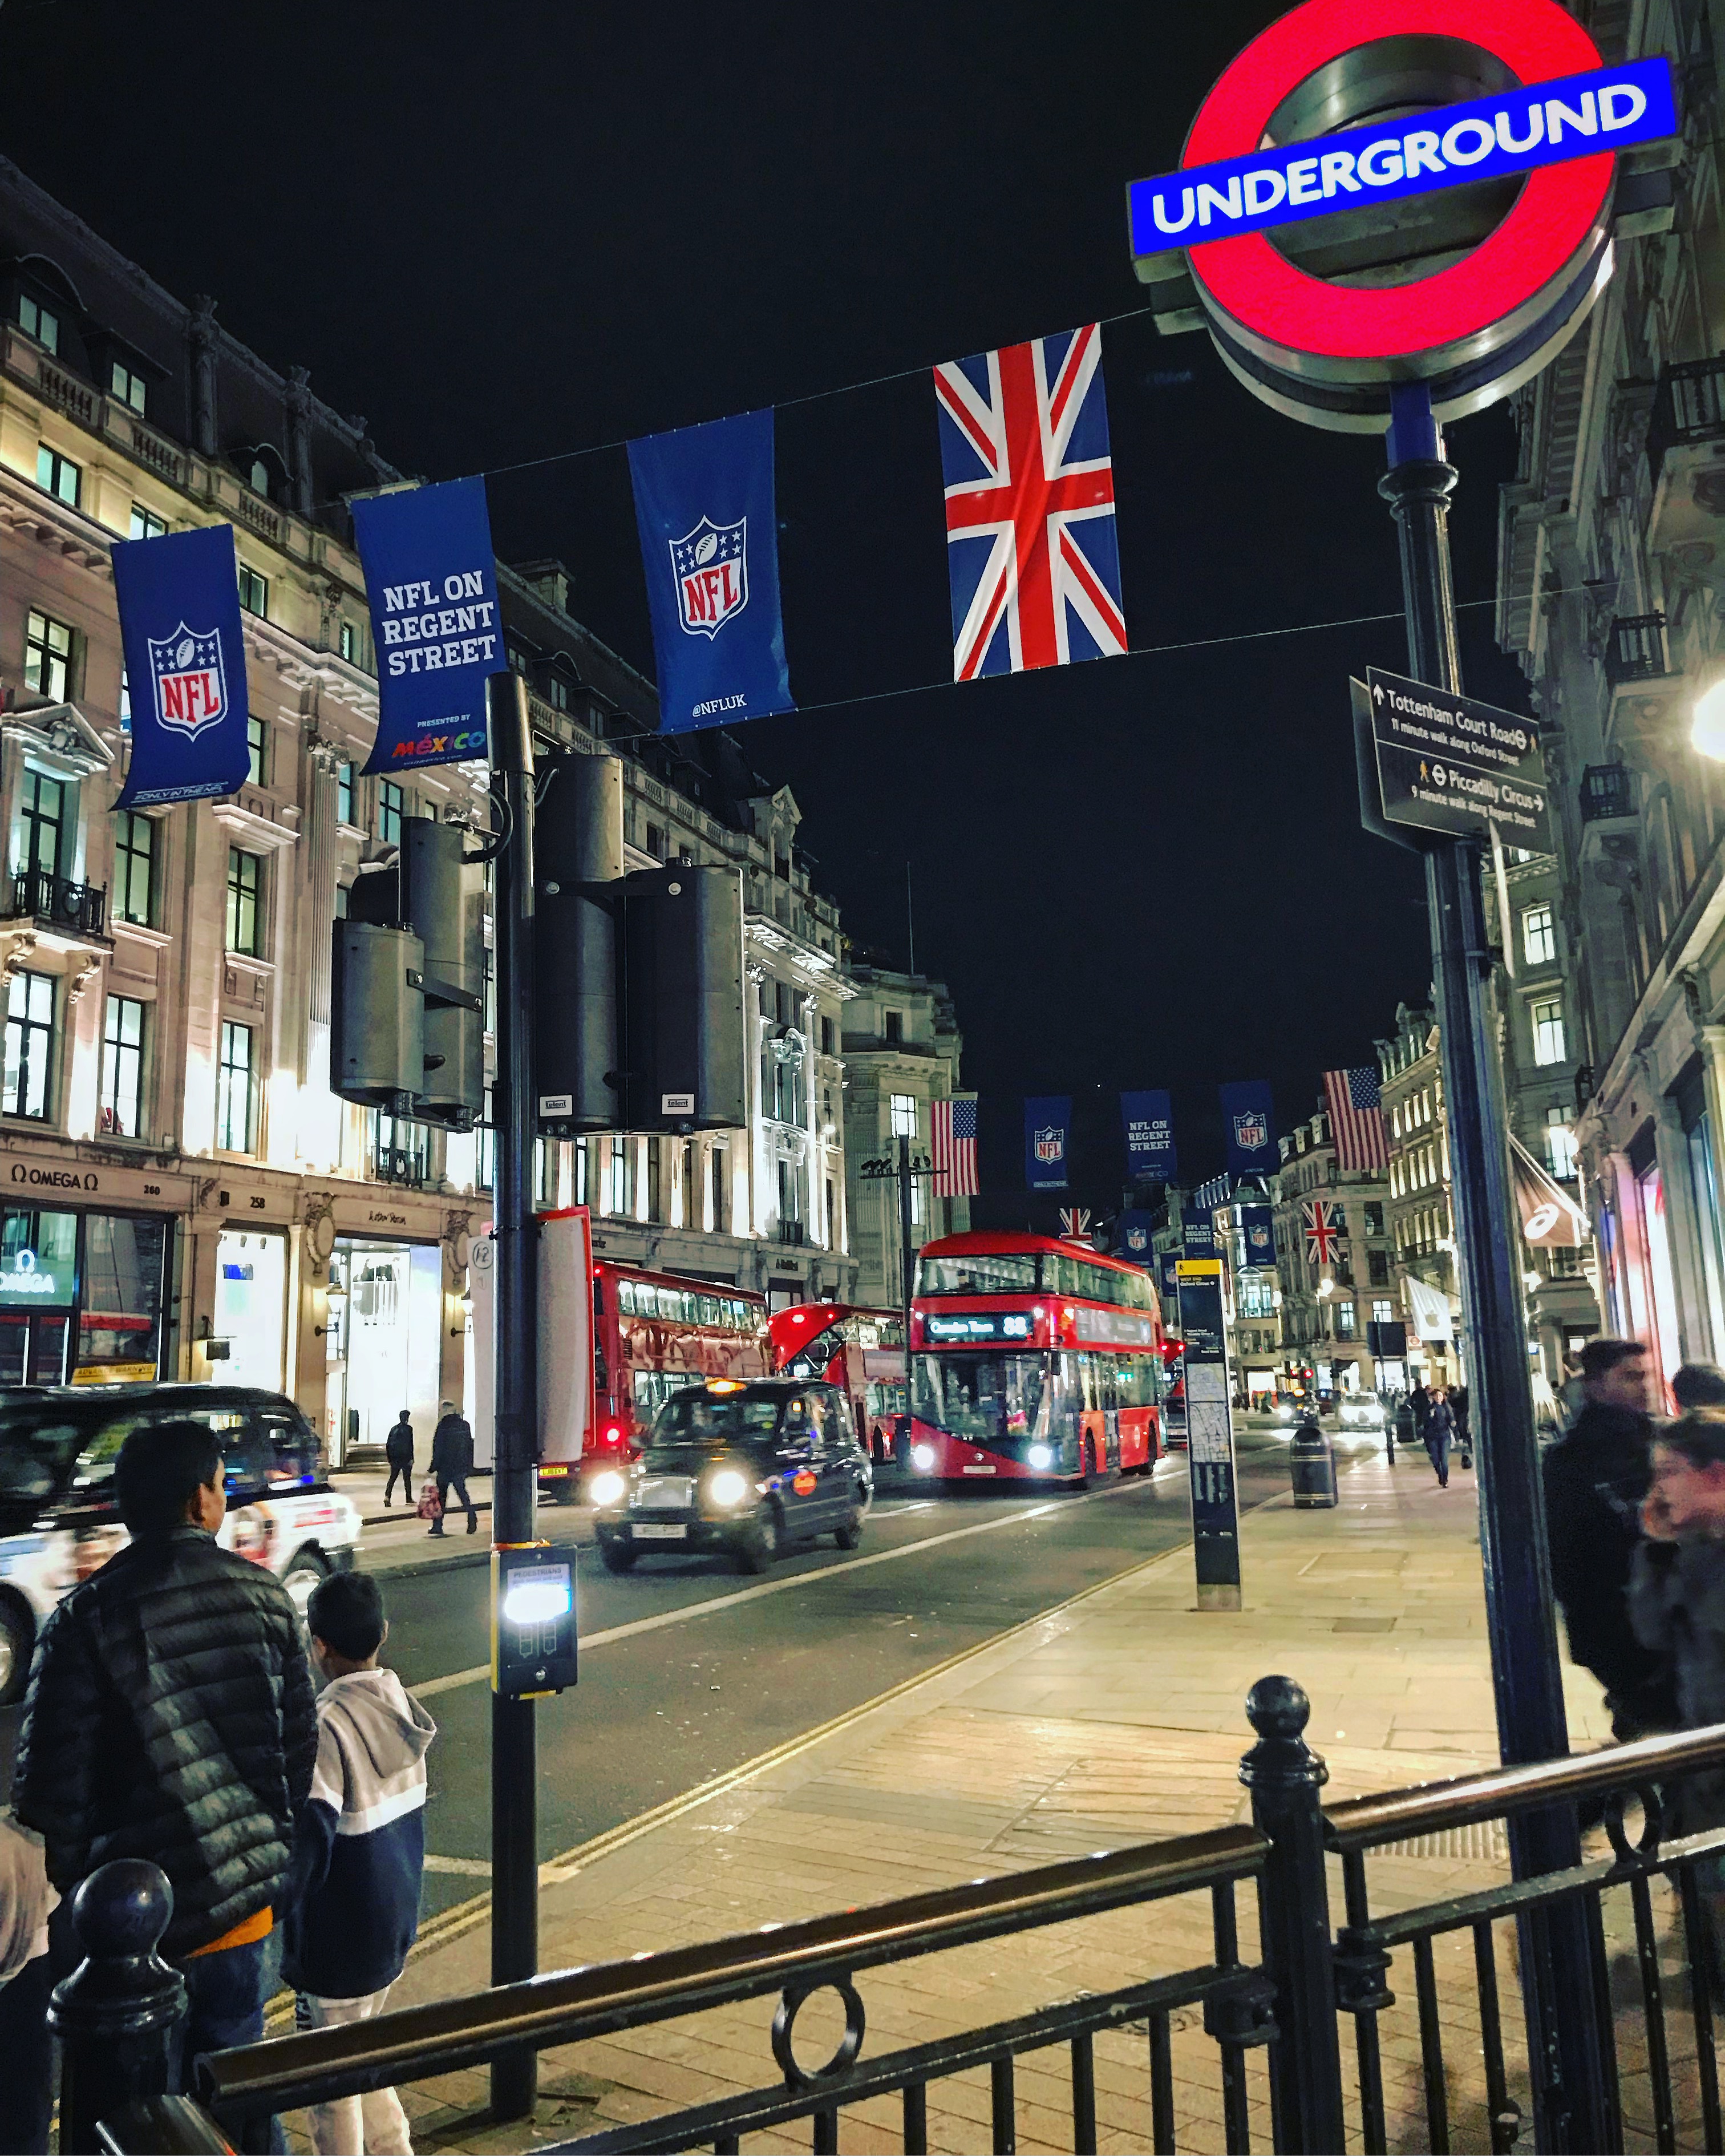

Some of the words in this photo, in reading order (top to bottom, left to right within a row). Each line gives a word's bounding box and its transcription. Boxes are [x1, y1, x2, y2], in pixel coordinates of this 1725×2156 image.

[1153, 84, 1647, 234] UNDERGROUND
[383, 580, 440, 613] NFL
[444, 570, 484, 602] ON
[684, 564, 738, 621] NFL
[381, 601, 495, 645] REGENT
[388, 634, 496, 676] STREET
[162, 672, 220, 723] NFL
[692, 693, 747, 717] @NFLUK
[417, 715, 460, 728] PRESENTED
[1387, 689, 1454, 726] Tottenham
[1456, 711, 1488, 737] Court
[1489, 721, 1516, 746] Road
[1391, 717, 1399, 731] 11
[1401, 721, 1429, 739] minute
[1430, 731, 1448, 745] walk
[1450, 735, 1471, 754] along
[1471, 741, 1497, 759] Oxford
[1497, 749, 1520, 767] Street
[1448, 769, 1500, 804] Piccadilly
[1501, 784, 1534, 810] Circus
[1411, 784, 1418, 798] 9
[1419, 788, 1448, 806] minute
[1448, 796, 1467, 810] walk
[1468, 800, 1488, 818] along
[1488, 804, 1514, 823] Regent
[1513, 811, 1536, 828] Street
[1128, 1130, 1171, 1141] REGENT
[1129, 1122, 1151, 1131] NFL
[1152, 1120, 1167, 1130] ON
[1240, 1128, 1264, 1145] NFL
[1038, 1143, 1061, 1158] NFL
[1129, 1140, 1171, 1151] STREET
[30, 1168, 81, 1189] OMEGA
[144, 1184, 160, 1196] 260
[250, 1196, 265, 1209] 258
[1003, 1316, 1027, 1335] 88
[513, 1567, 562, 1579] PEDESTRIANS
